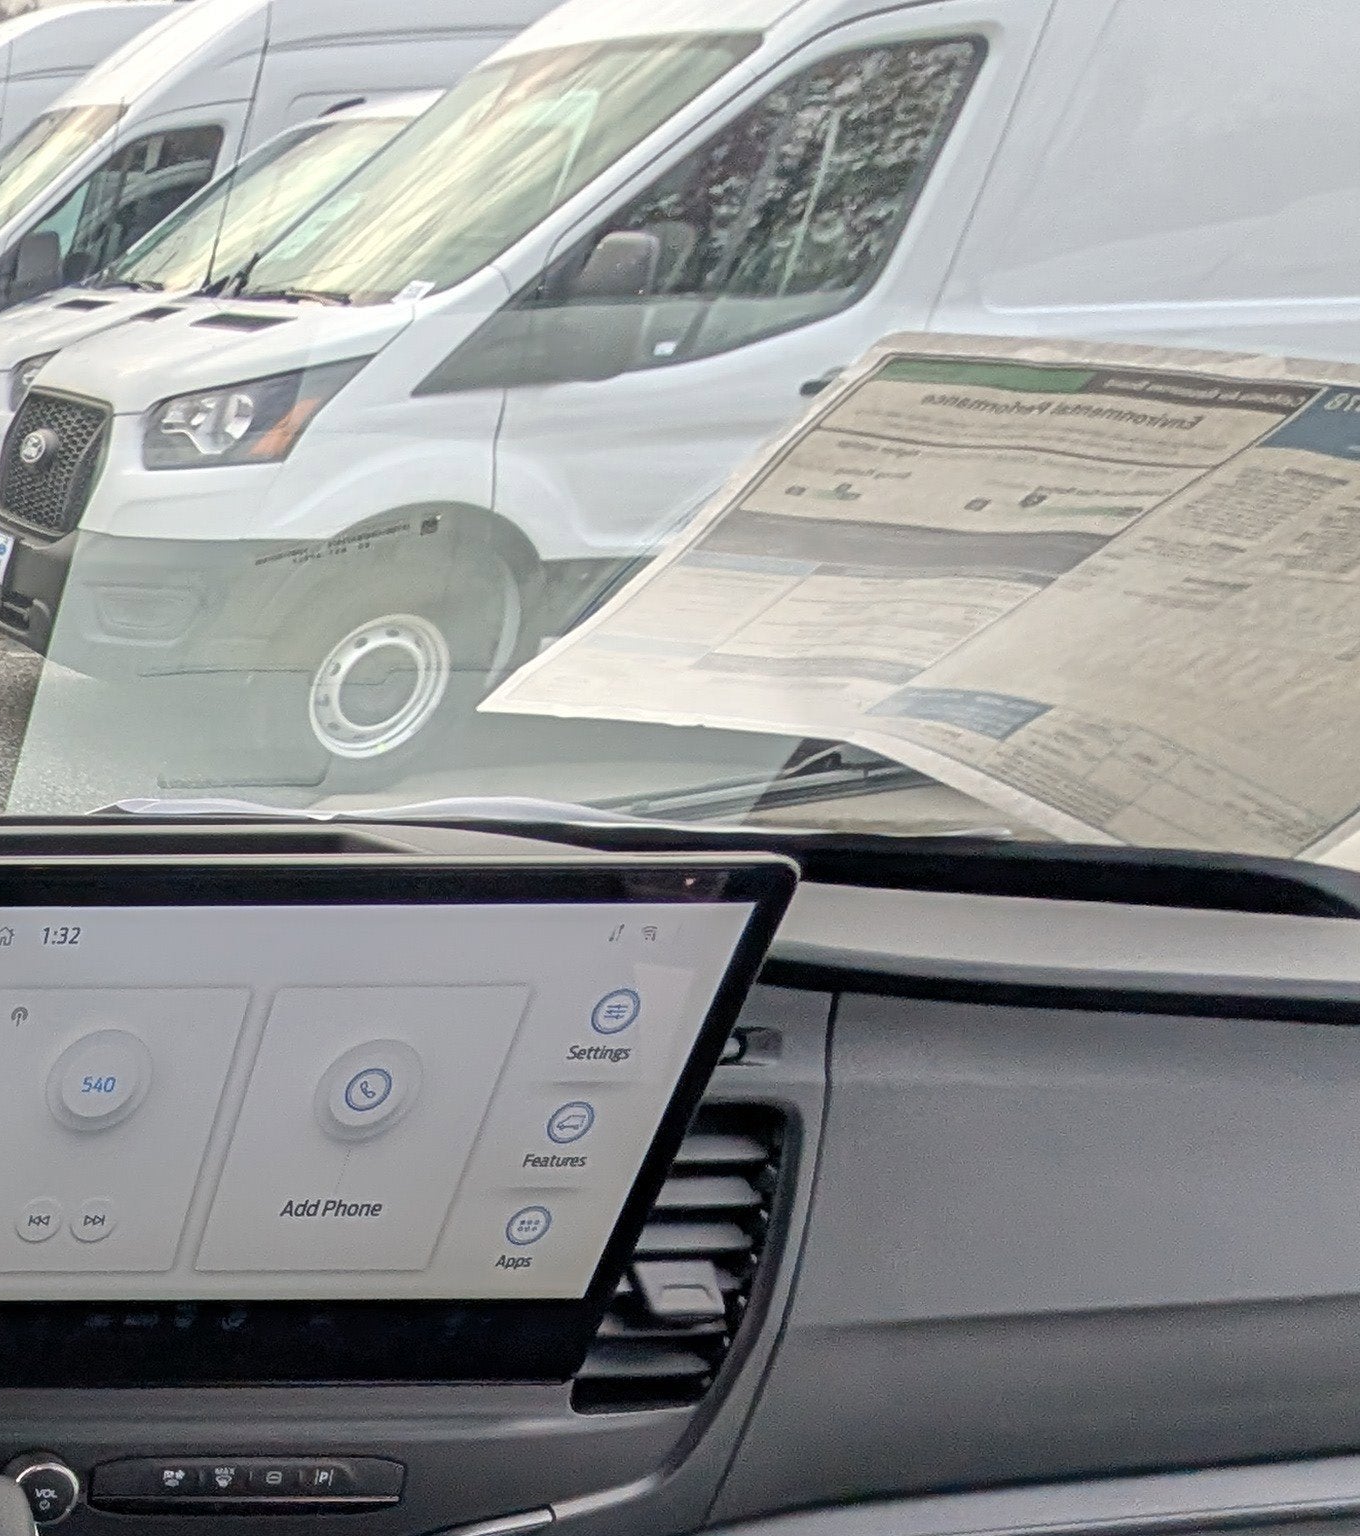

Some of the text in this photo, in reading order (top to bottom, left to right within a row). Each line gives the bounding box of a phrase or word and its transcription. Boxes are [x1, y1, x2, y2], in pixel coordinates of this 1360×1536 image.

[41, 925, 81, 947] 1:32
[566, 1043, 631, 1063] Settings
[81, 1075, 116, 1095] 540
[522, 1152, 587, 1169] Features
[280, 1199, 383, 1219] Add Phone
[495, 1254, 532, 1269] Apps
[34, 1488, 58, 1499] VOL
